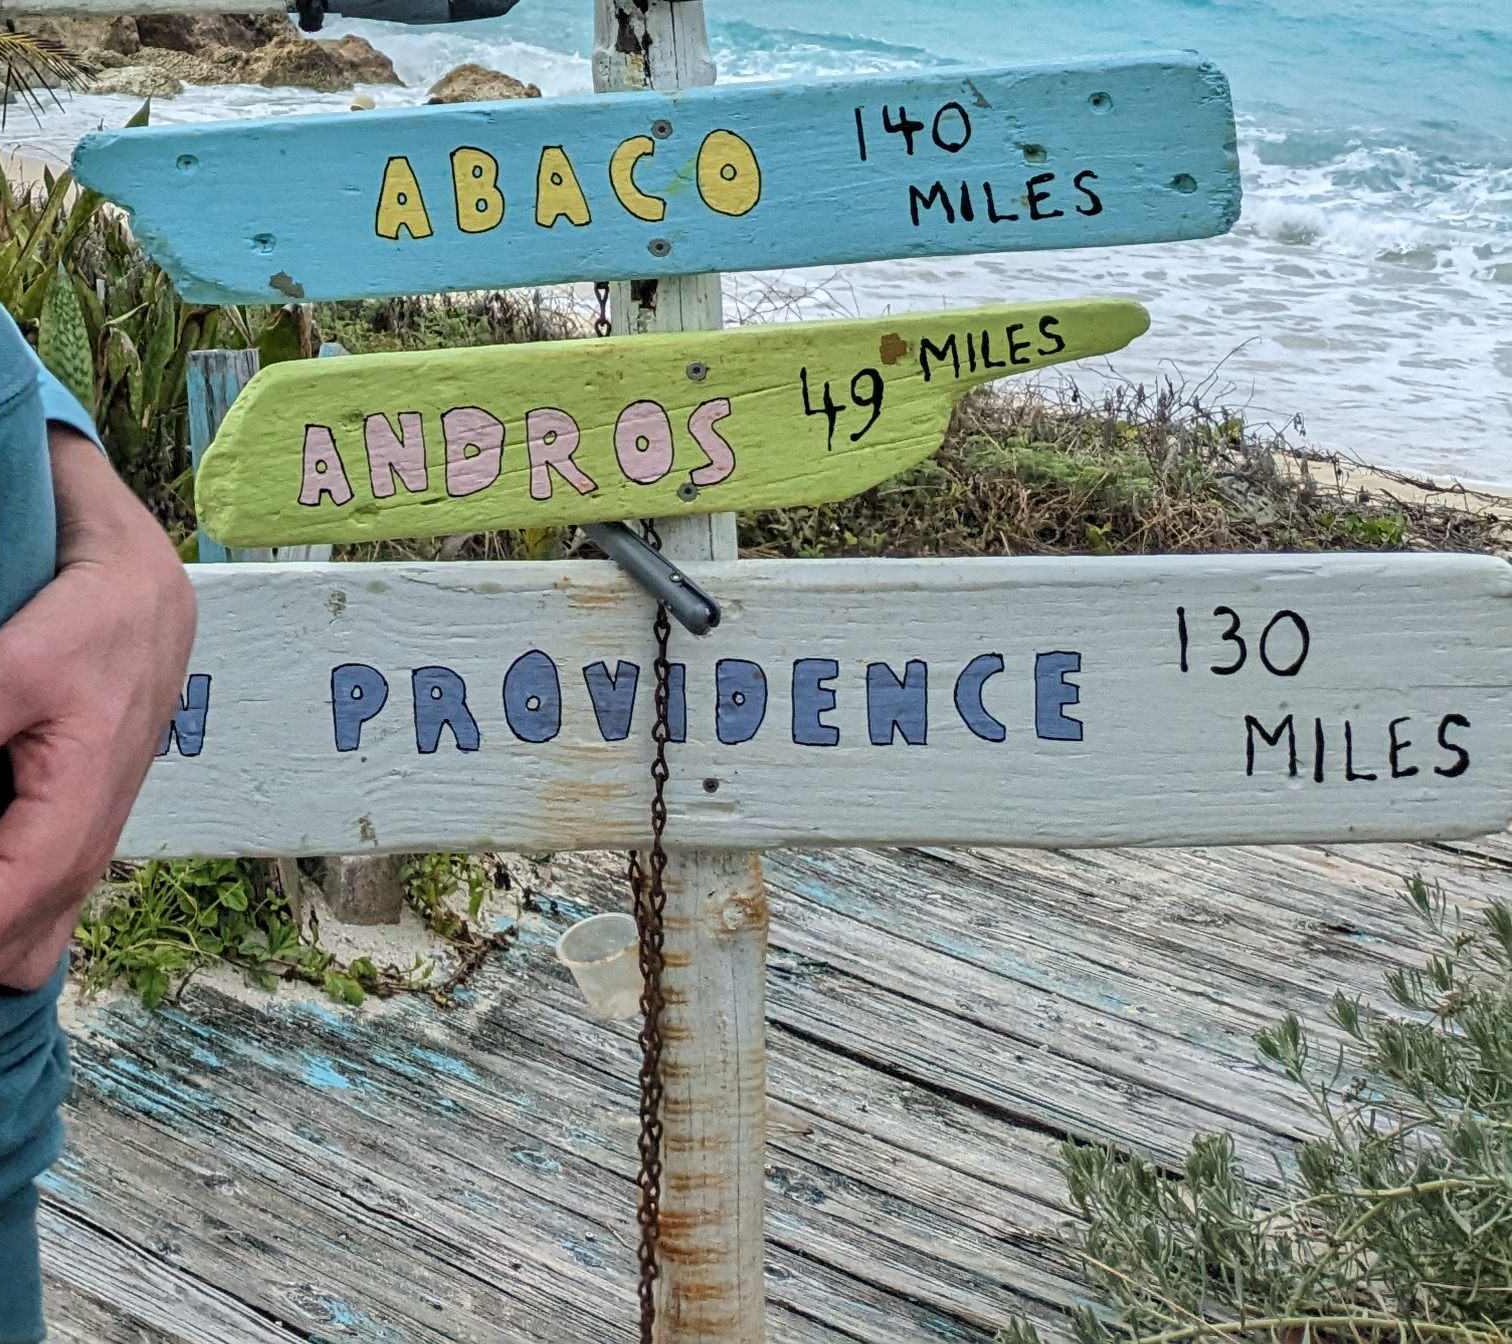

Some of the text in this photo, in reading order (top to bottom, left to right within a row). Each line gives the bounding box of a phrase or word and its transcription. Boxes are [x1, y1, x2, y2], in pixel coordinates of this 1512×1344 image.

[374, 100, 973, 241] ABACO 140
[909, 168, 1104, 227] MILES
[296, 313, 1067, 507] ANDROS 49 MILES
[1176, 605, 1311, 678] 130
[331, 648, 1084, 755] PROVIDENCE
[1243, 712, 1473, 780] MILES
